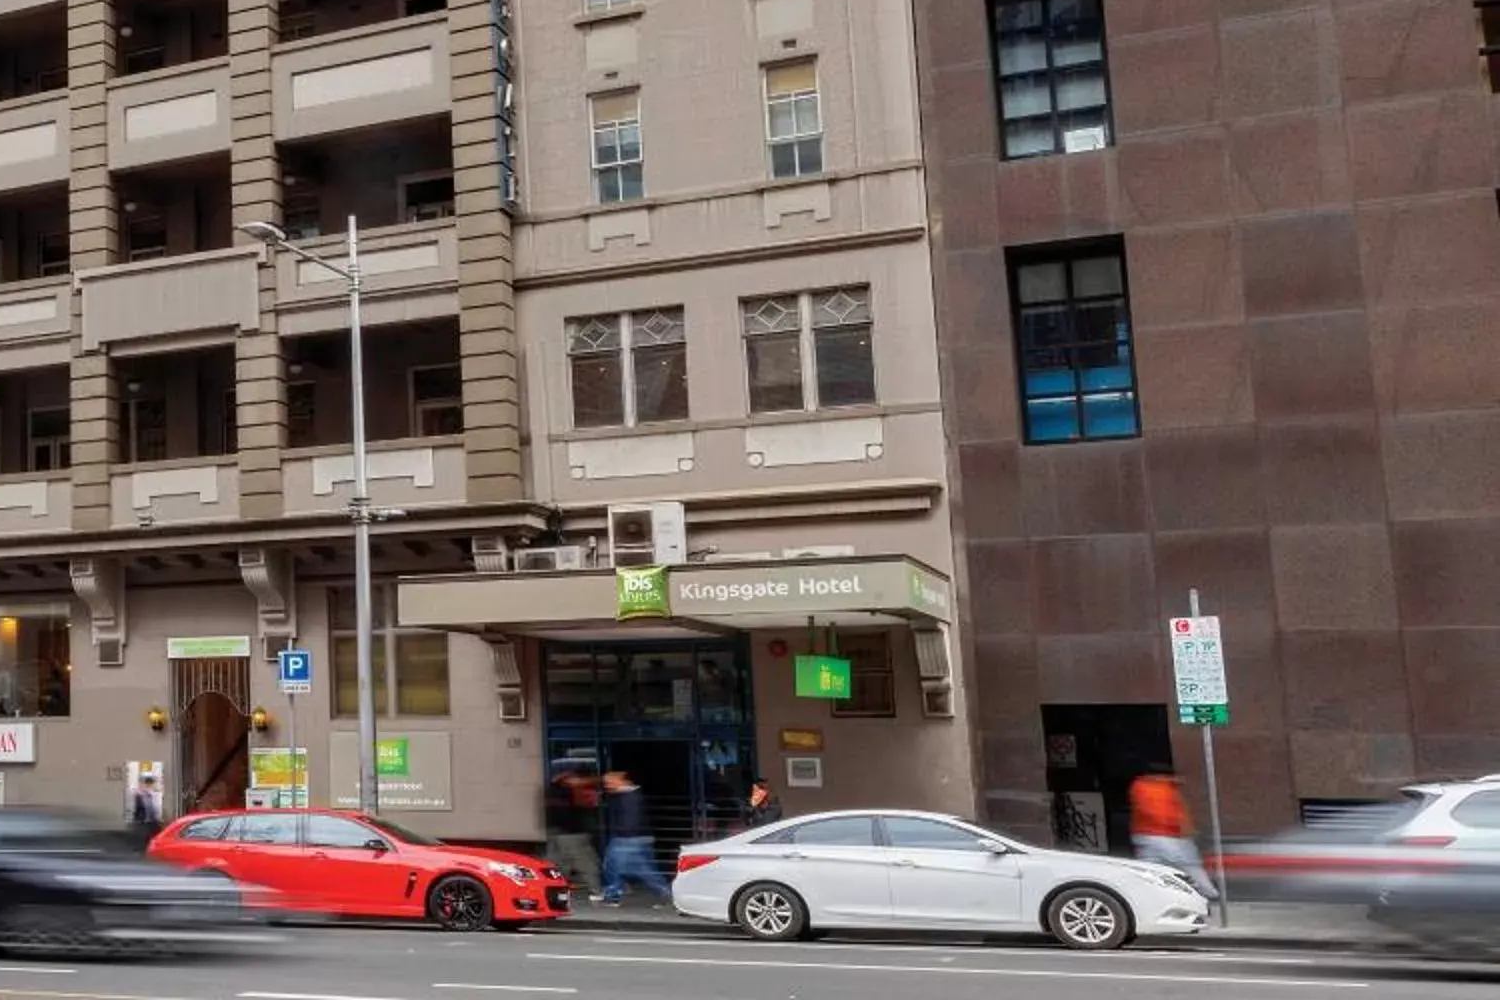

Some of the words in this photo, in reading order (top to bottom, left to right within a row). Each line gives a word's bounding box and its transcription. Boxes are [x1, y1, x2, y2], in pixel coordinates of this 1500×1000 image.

[679, 581, 790, 602] Kingsgate
[799, 574, 863, 596] Hotel
[289, 656, 303, 677] P
